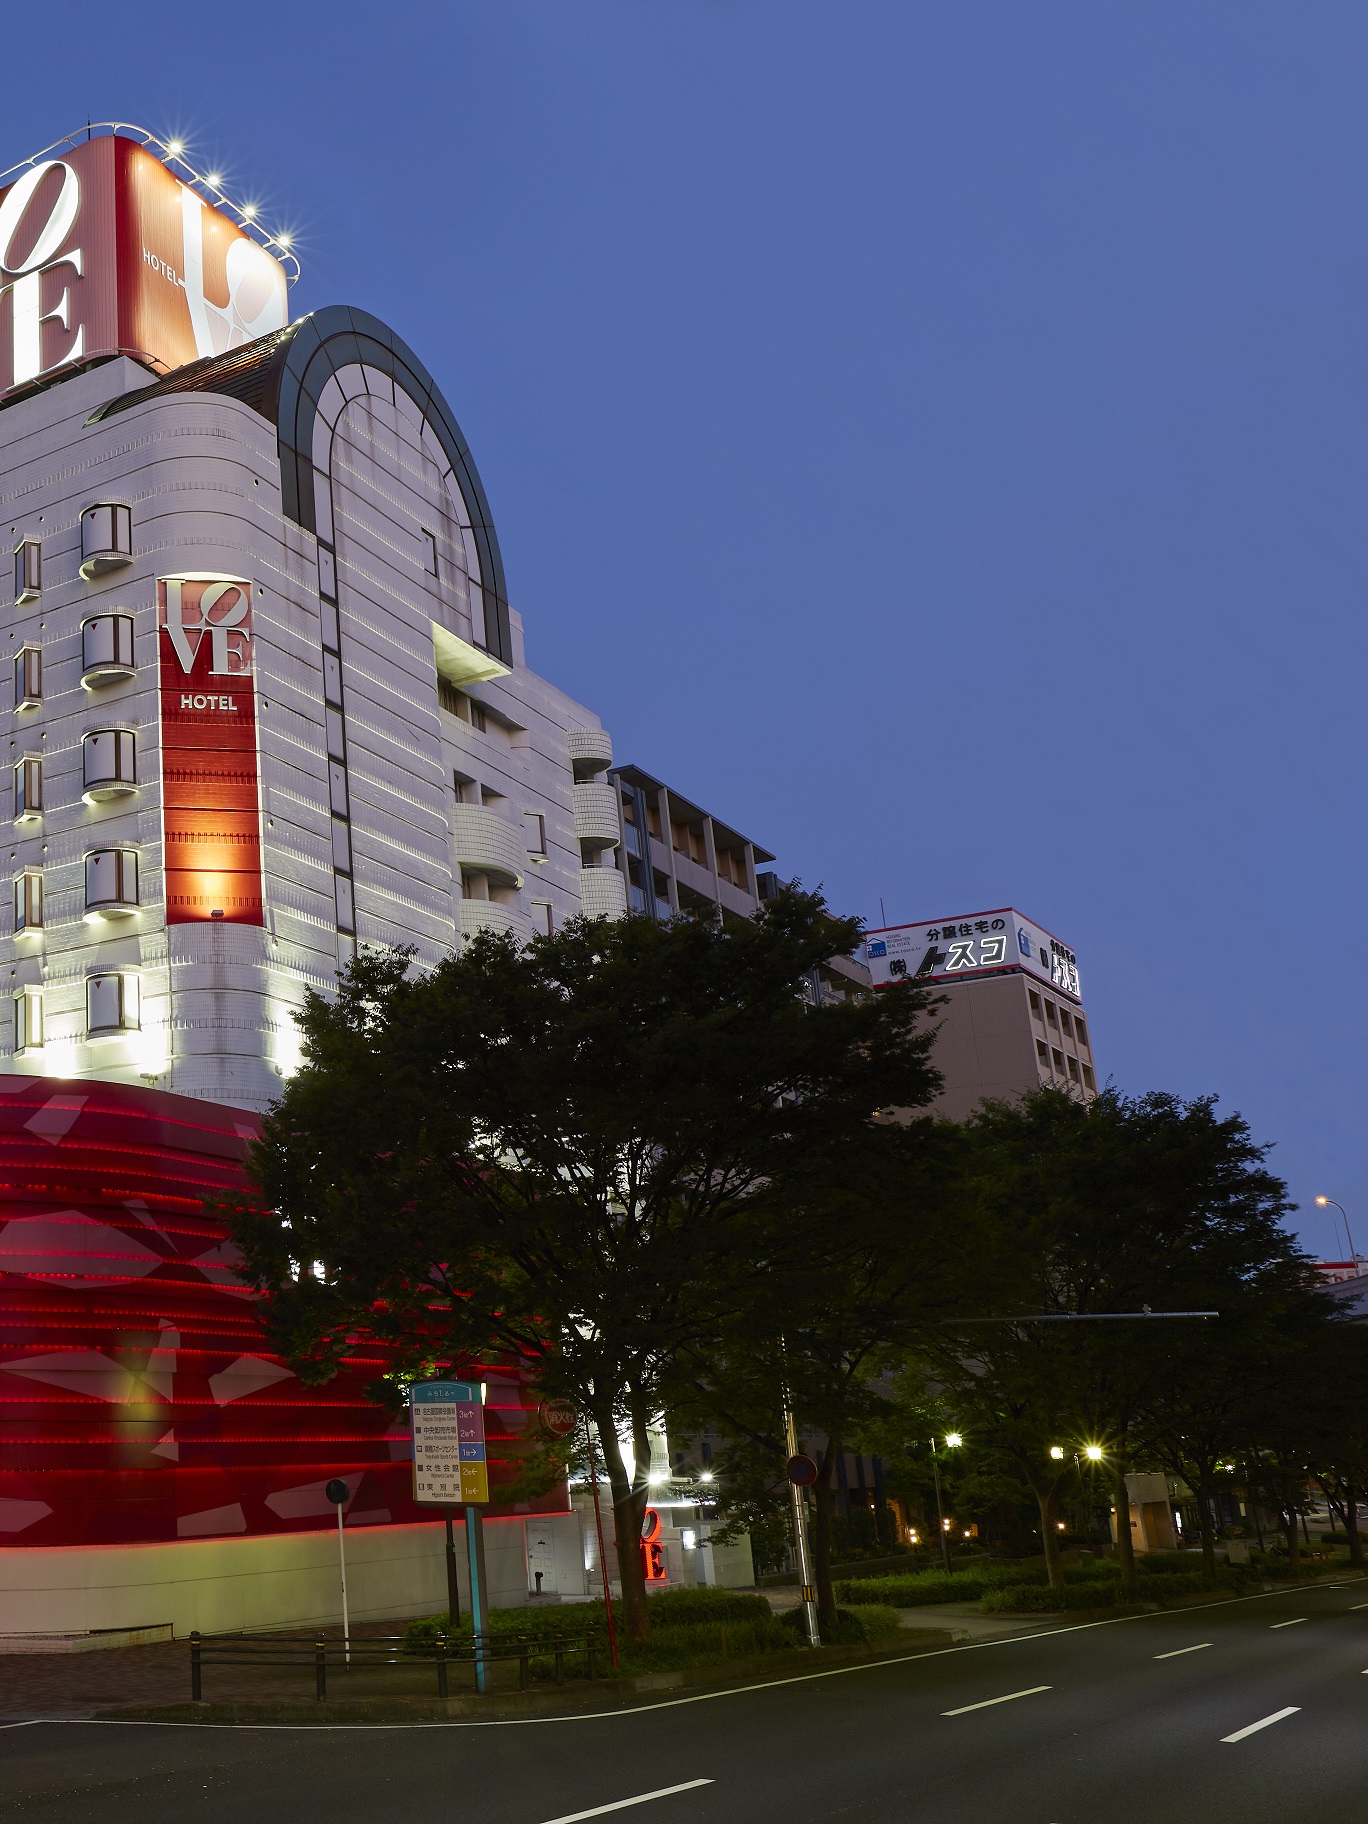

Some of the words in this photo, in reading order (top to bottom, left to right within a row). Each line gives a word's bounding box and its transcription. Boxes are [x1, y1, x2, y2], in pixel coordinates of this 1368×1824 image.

[142, 246, 180, 288] HOTEL
[181, 694, 237, 711] HOTEL
[926, 919, 1006, 942] 分譲住宅の
[916, 935, 1007, 976] トスコ
